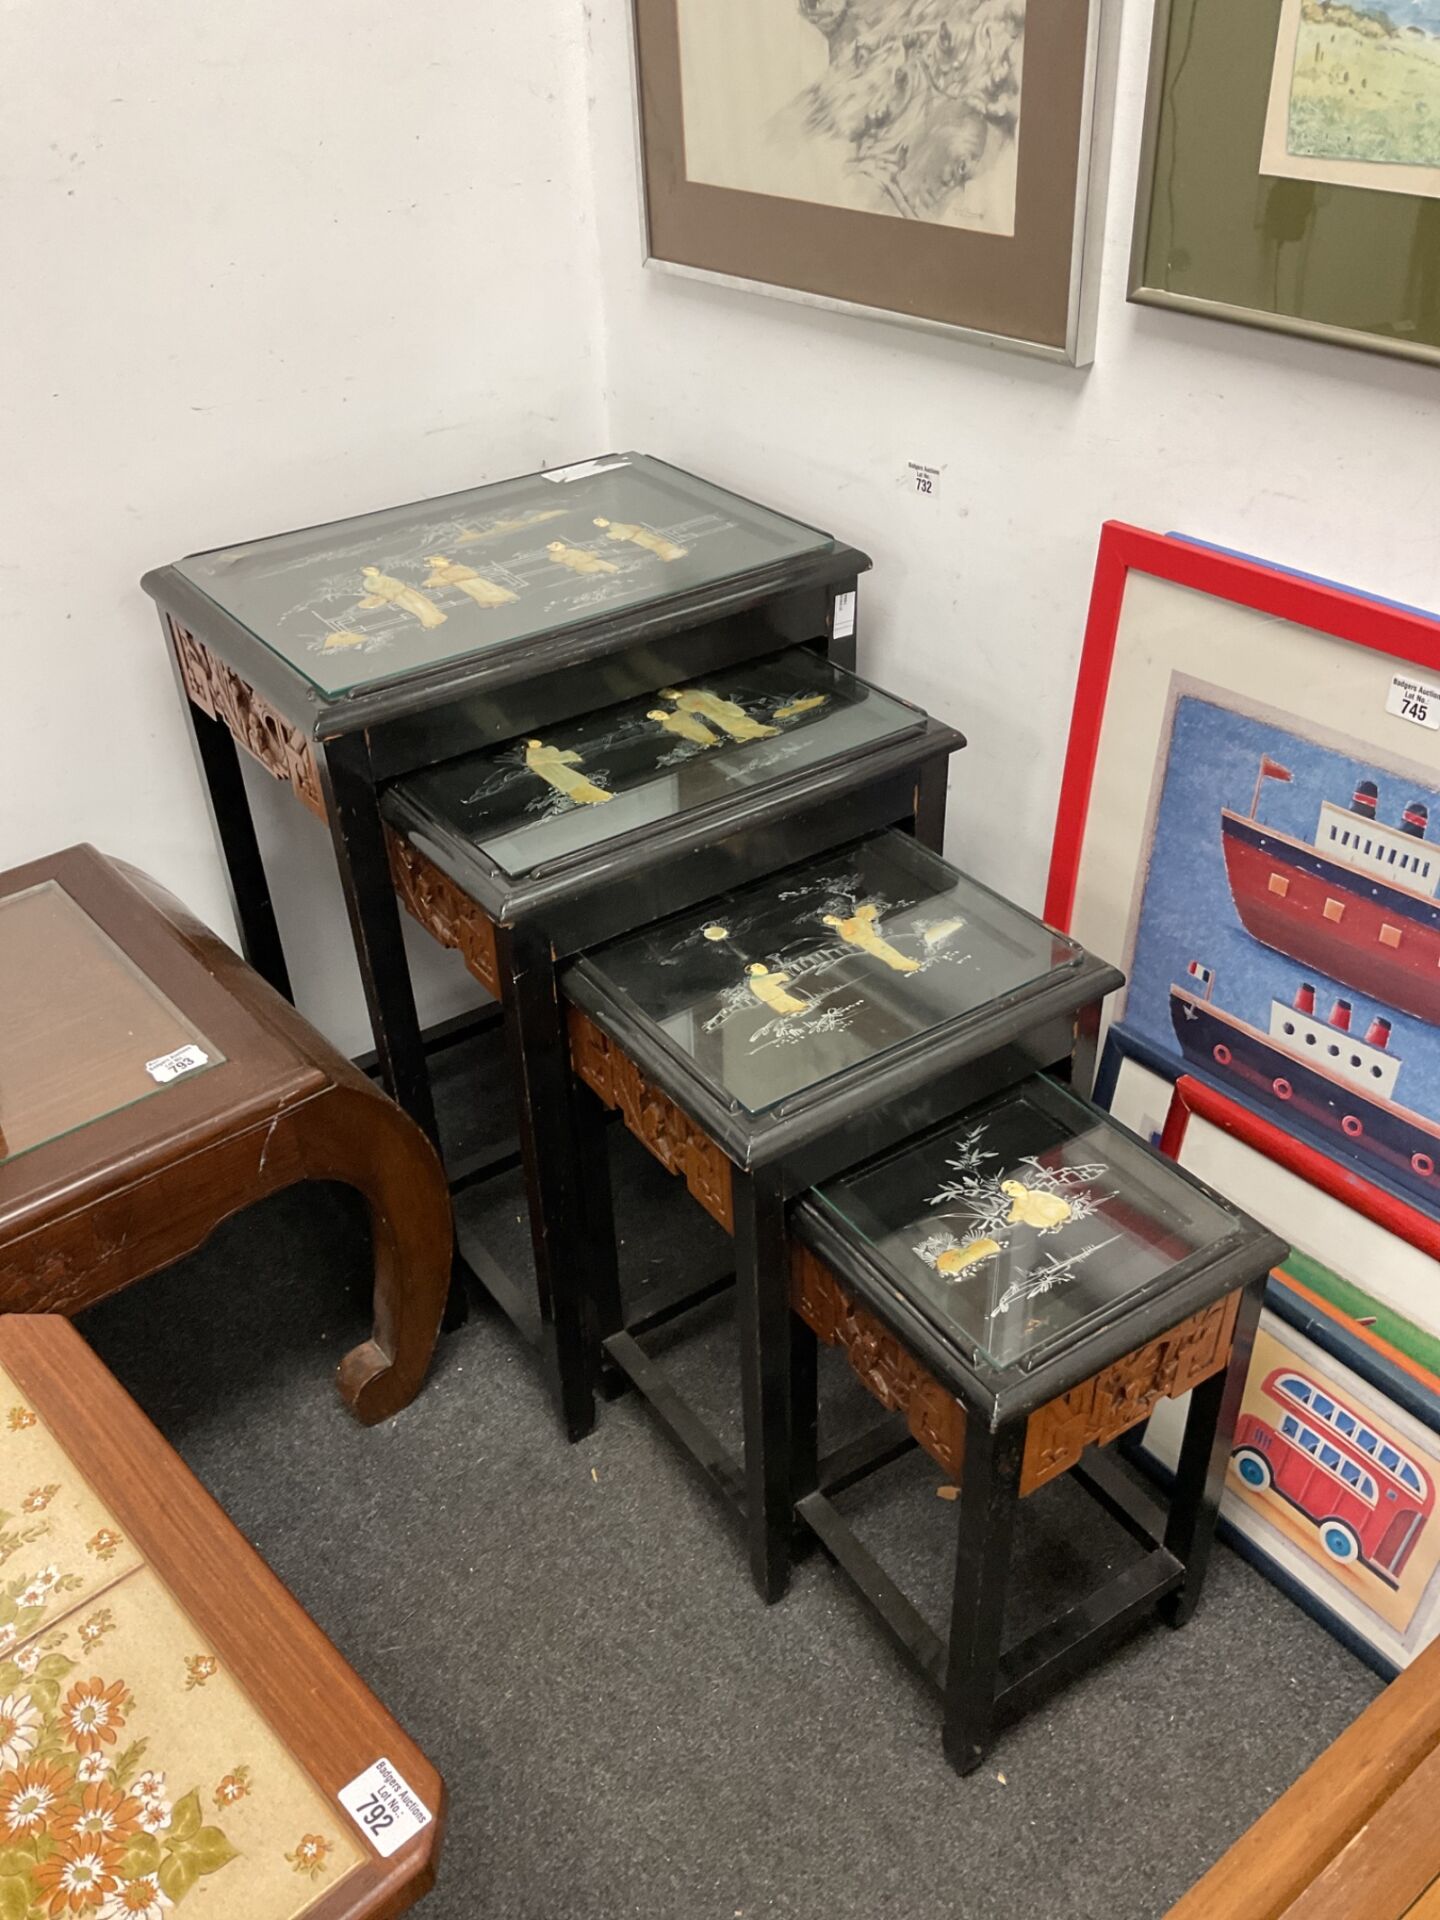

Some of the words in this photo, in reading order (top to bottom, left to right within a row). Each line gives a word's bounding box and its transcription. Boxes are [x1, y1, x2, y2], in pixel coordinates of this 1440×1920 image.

[916, 477, 932, 493] 732
[1393, 677, 1417, 691] Badgers
[1418, 686, 1440, 700] Auction
[1404, 690, 1415, 700] Lot
[1401, 698, 1428, 721] 745
[167, 1057, 195, 1073] 793
[376, 1761, 402, 1793] Badgers
[398, 1790, 426, 1824] Auctions
[377, 1785, 392, 1802] Lot
[387, 1798, 404, 1819] No.:
[356, 1792, 394, 1836] 792
